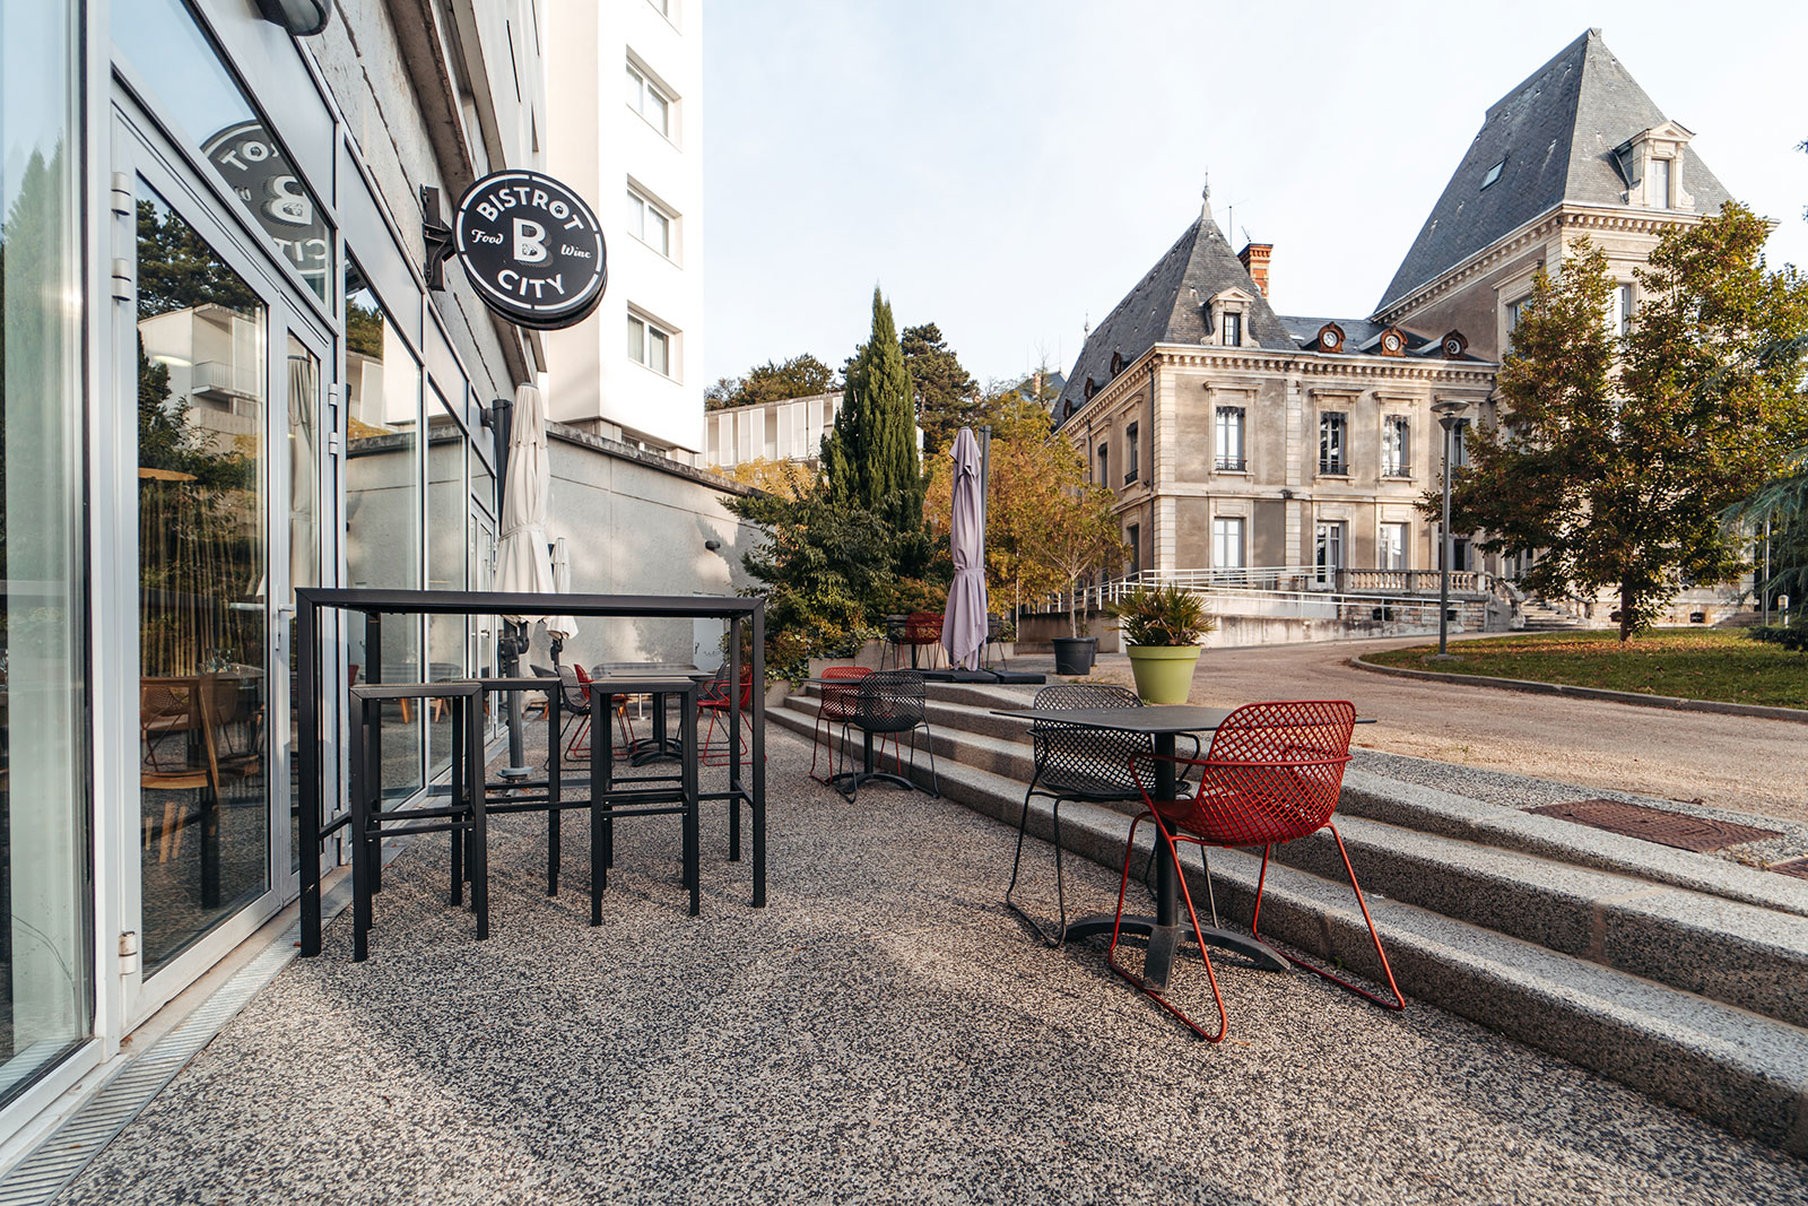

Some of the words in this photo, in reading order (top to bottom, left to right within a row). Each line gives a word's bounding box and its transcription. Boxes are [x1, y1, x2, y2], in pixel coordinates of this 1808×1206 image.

[476, 186, 585, 231] BISTROT
[471, 228, 504, 245] Food
[512, 217, 553, 264] B
[560, 243, 592, 259] Wine
[497, 269, 565, 299] CITY
